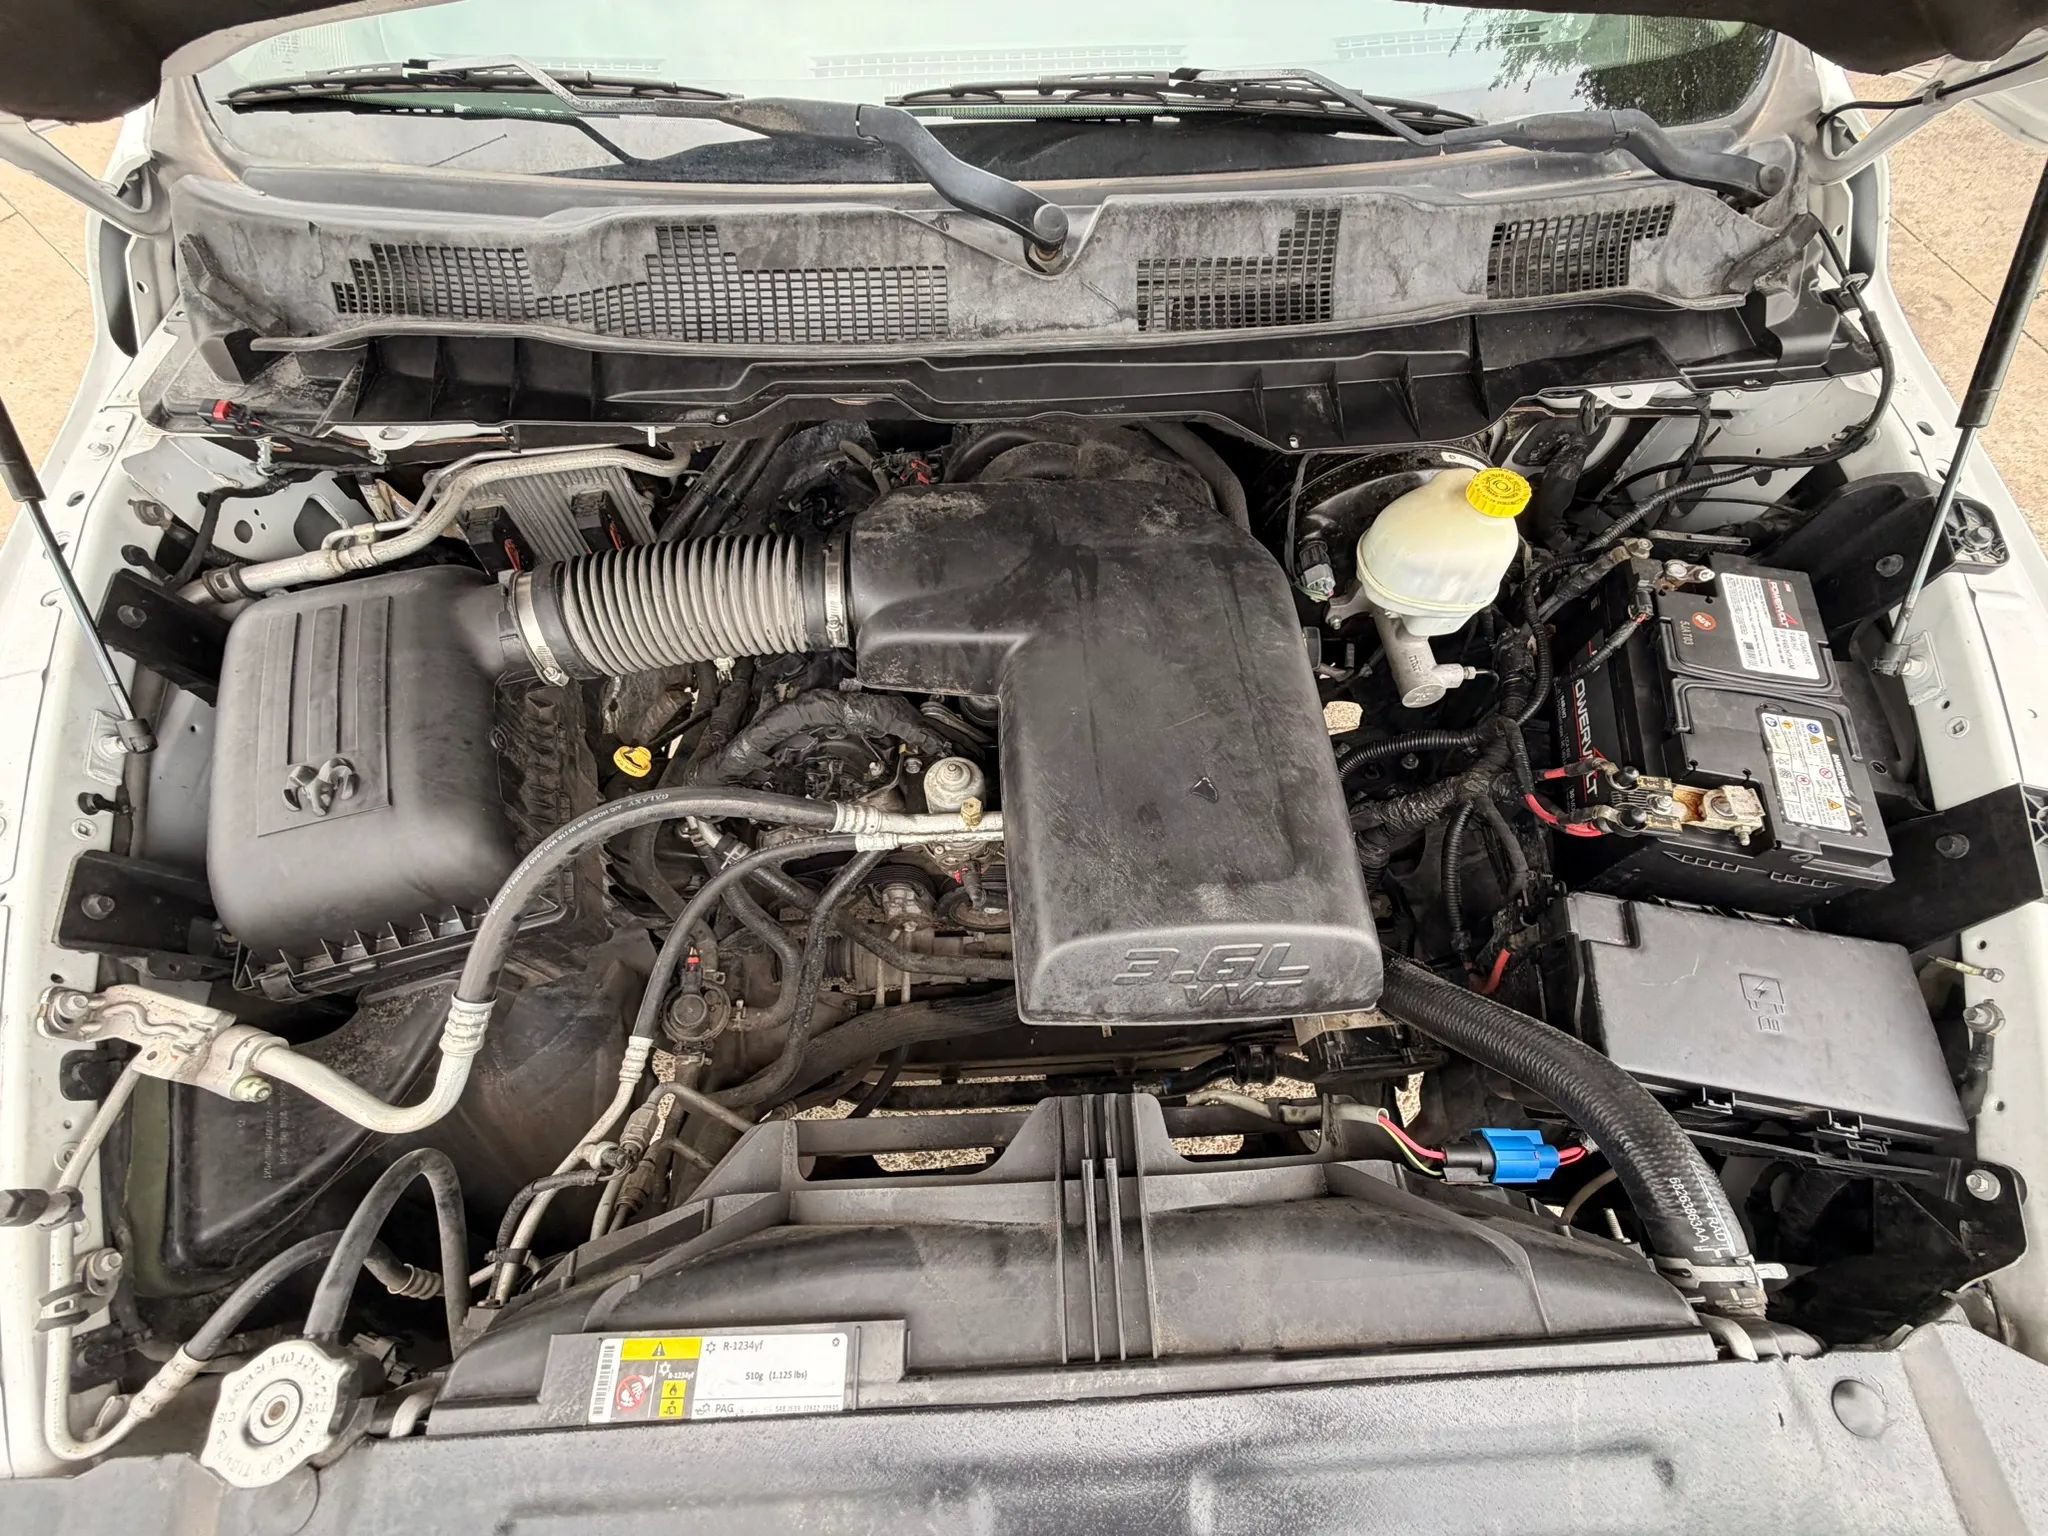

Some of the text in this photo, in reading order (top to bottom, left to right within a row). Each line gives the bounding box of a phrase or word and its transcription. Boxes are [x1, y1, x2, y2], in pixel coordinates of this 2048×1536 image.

[1574, 677, 1599, 796] OWERVLT
[626, 792, 670, 808] GALAXY
[1111, 942, 1311, 986] 3.6L
[1183, 979, 1304, 1009] VVT
[1669, 1176, 1710, 1244] 68263863AA
[1706, 1216, 1727, 1243] RAD
[722, 1340, 763, 1353] R-1234yf
[745, 1370, 808, 1381] 510g (1.125 lbs)
[715, 1403, 735, 1415] PAG
